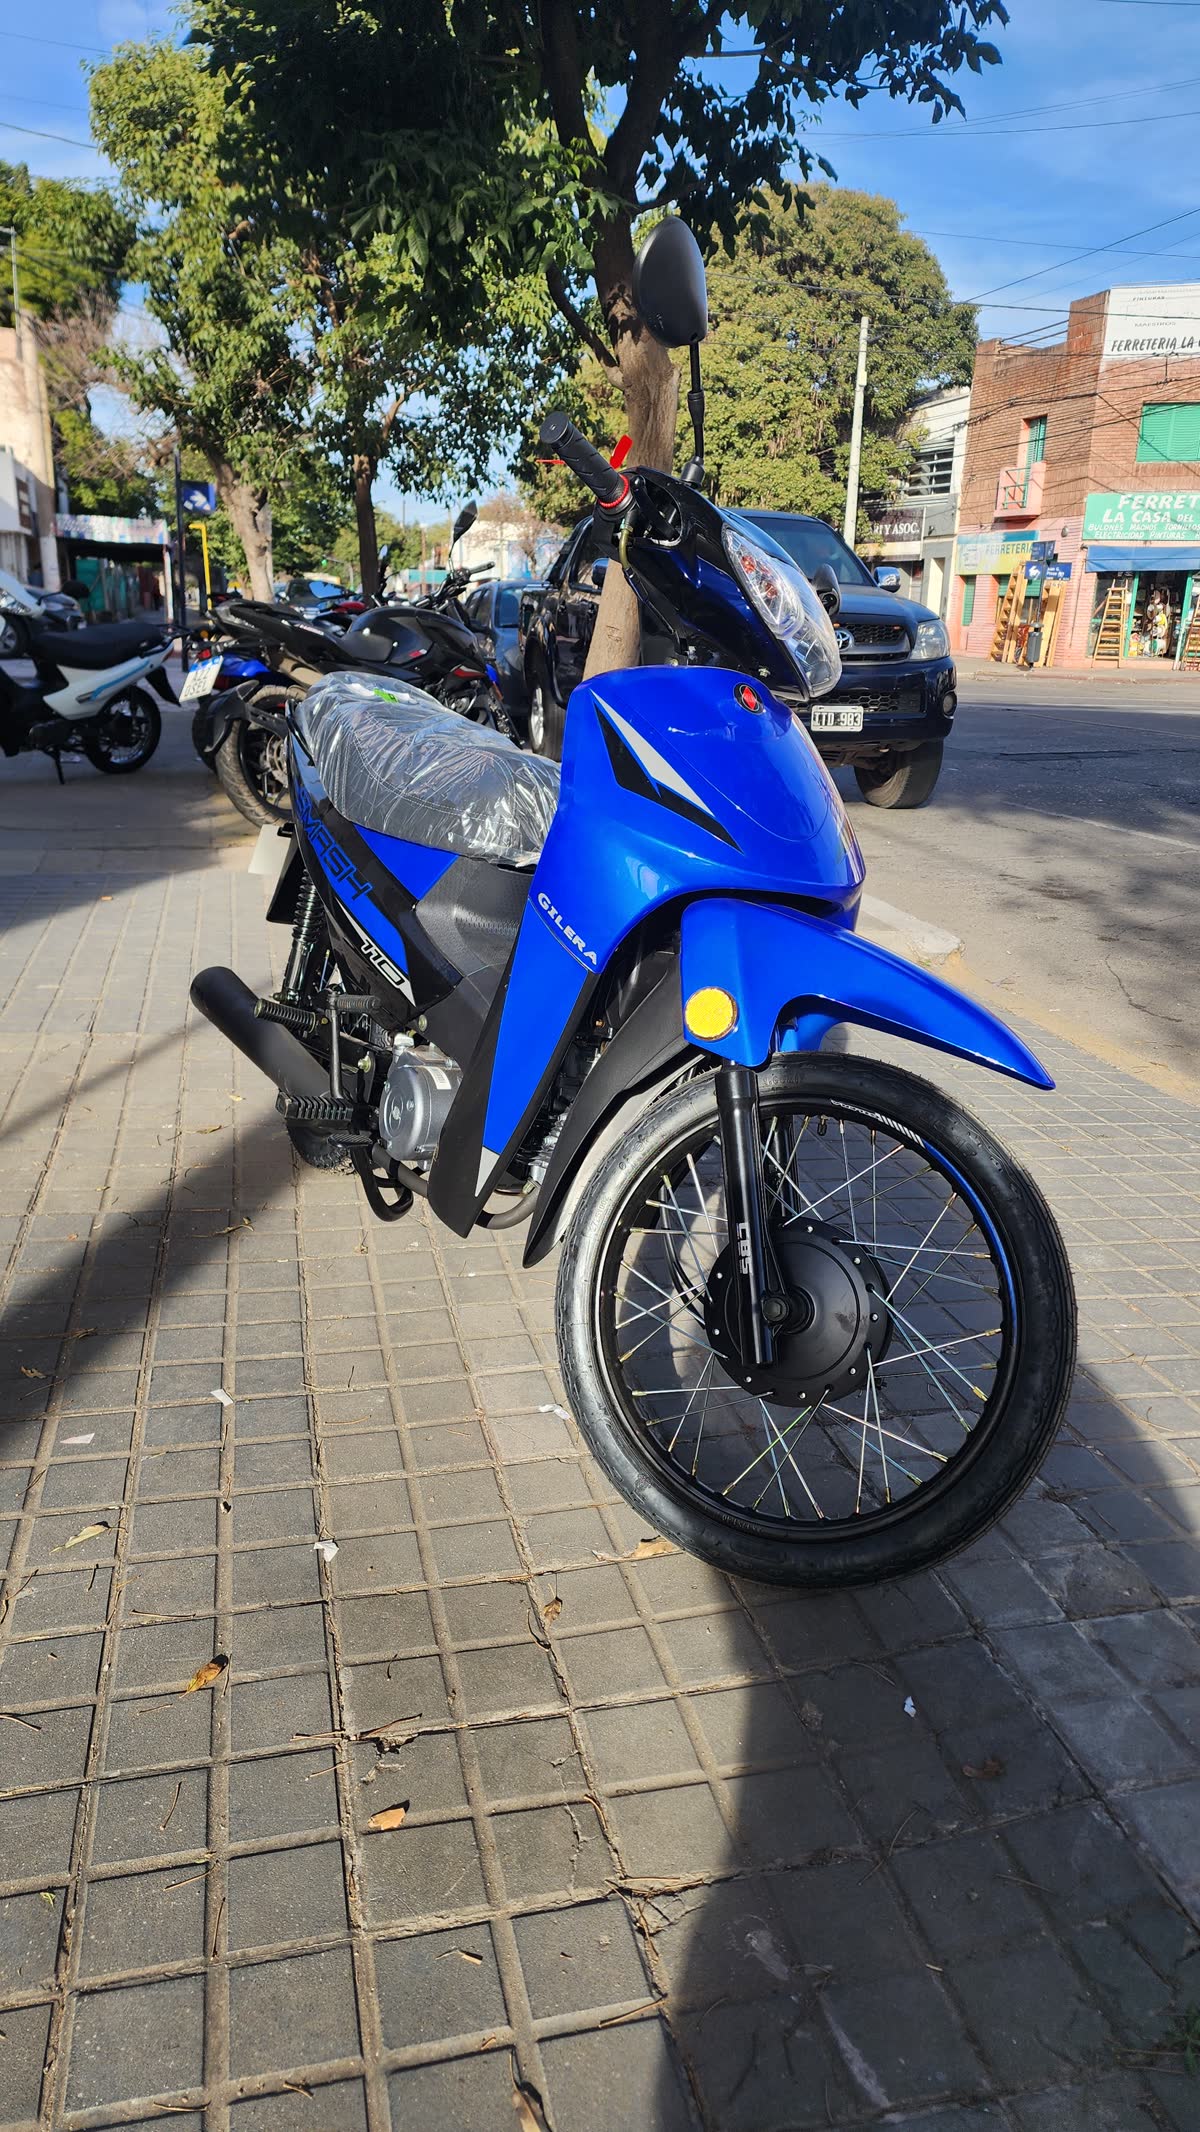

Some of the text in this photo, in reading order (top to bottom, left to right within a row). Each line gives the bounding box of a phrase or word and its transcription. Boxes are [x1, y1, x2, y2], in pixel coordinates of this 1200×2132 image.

[1111, 335, 1194, 352] FERRETERIA LA
[1102, 508, 1194, 523] LA CASA DEL
[884, 524, 892, 535] Y
[892, 521, 920, 535] ASOC.
[1094, 531, 1145, 539] ELECTRICIDAD
[840, 711, 861, 727] 983
[297, 784, 374, 901] SMASH
[537, 892, 597, 966] GILERA
[736, 1222, 753, 1275] CBS
